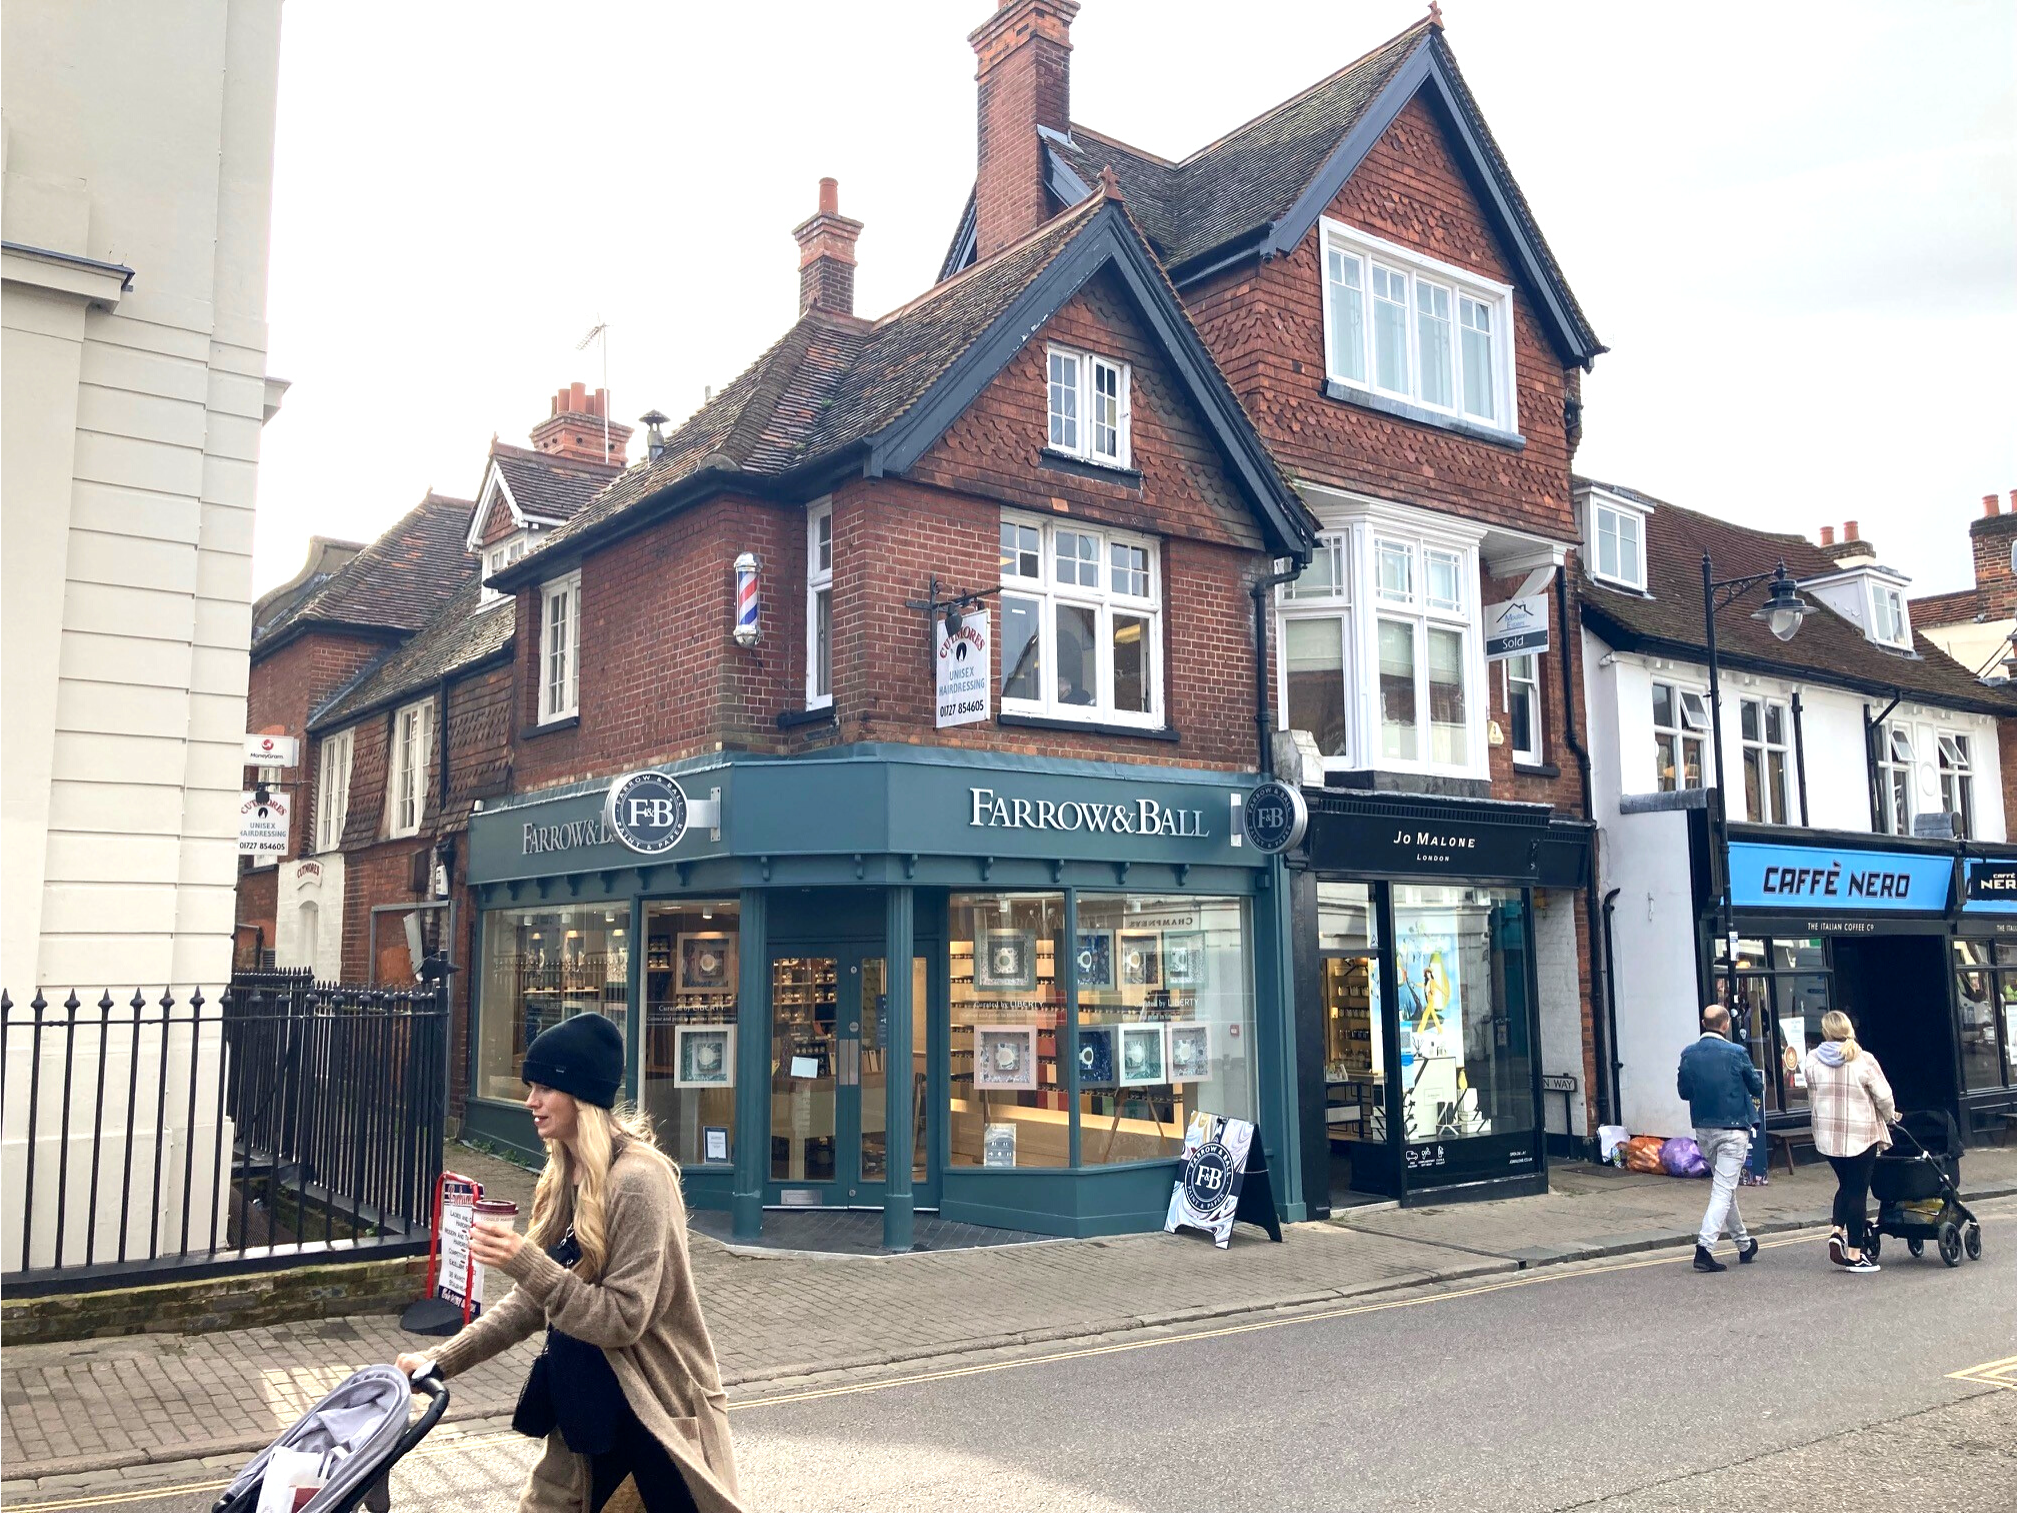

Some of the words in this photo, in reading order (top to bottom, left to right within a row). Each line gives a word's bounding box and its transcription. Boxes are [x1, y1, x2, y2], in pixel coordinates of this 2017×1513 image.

[1502, 636, 1524, 650] Sold
[950, 666, 974, 680] UNISEX
[939, 678, 985, 697] HAIRDRESSING
[940, 705, 956, 717] 01727
[958, 700, 984, 714] 854605
[617, 775, 651, 805] FARROW
[667, 783, 684, 807] BALL
[241, 799, 287, 817] CUTORES
[628, 798, 674, 827] F&B
[250, 822, 276, 830] UNISEX
[1257, 807, 1284, 828] F&B
[617, 821, 641, 849] PAINT
[658, 823, 684, 849] PAPER
[1416, 832, 1476, 849] MALONE
[239, 842, 257, 850] 01727
[259, 842, 285, 850] 854605
[1416, 854, 1450, 862] LONDON
[297, 864, 320, 879] CUTMORES
[1763, 860, 1842, 896] CAFFÈ
[1848, 870, 1911, 899] NERO
[1808, 922, 1819, 931] THE
[1820, 922, 1842, 931] ITALIAN
[1844, 923, 1865, 932] COFFEE
[1554, 1079, 1572, 1089] WAY
[1190, 1146, 1217, 1169] FARROW
[1223, 1153, 1233, 1177] BALL
[1194, 1164, 1222, 1190] F&B
[1188, 1186, 1200, 1206] PAINT
[1207, 1194, 1225, 1209] PAPER
